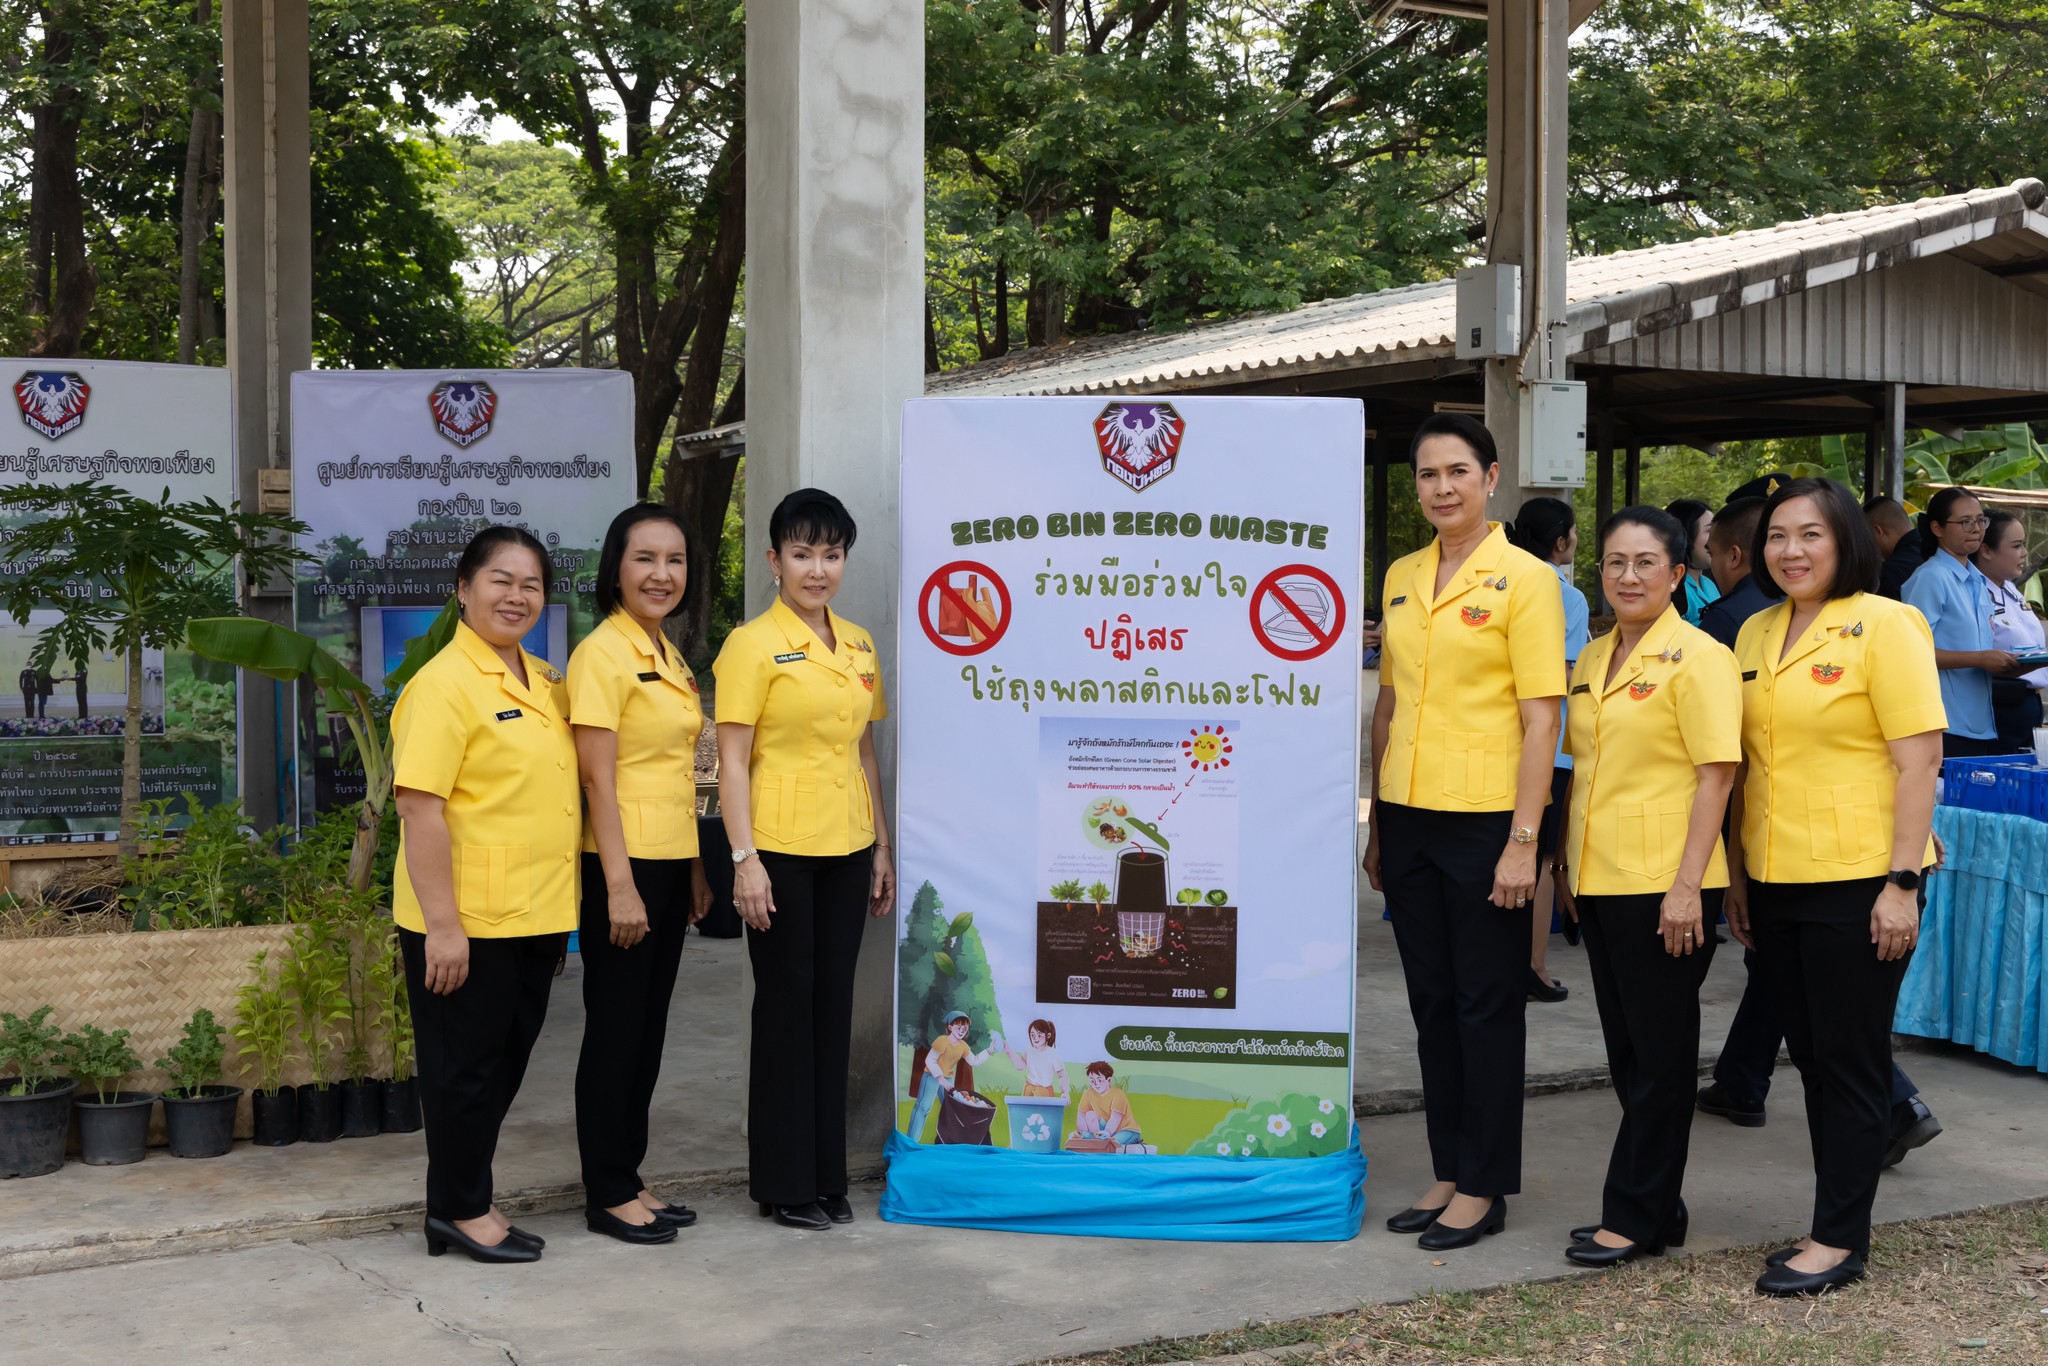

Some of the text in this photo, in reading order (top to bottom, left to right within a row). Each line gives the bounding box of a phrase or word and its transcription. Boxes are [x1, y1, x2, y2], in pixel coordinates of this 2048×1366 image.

[317, 455, 611, 487] ศูนย์การเรียนรู้เศรษฐกิจพอเพียง
[418, 493, 522, 516] กองบิน ๒๑
[951, 511, 1329, 550] ZERO BIN ZERO WASTE
[313, 578, 431, 600] เศรษฐกิจพอเพียง
[1034, 556, 1248, 598] ร่วมมือร่วมใจ
[1084, 612, 1189, 661] ปฏิเสธ
[961, 664, 1321, 713] ใช้ถุงพลาสติกและโฟม
[1171, 988, 1197, 998] ZERO
[1120, 1034, 1162, 1051] ช่วยกัน
